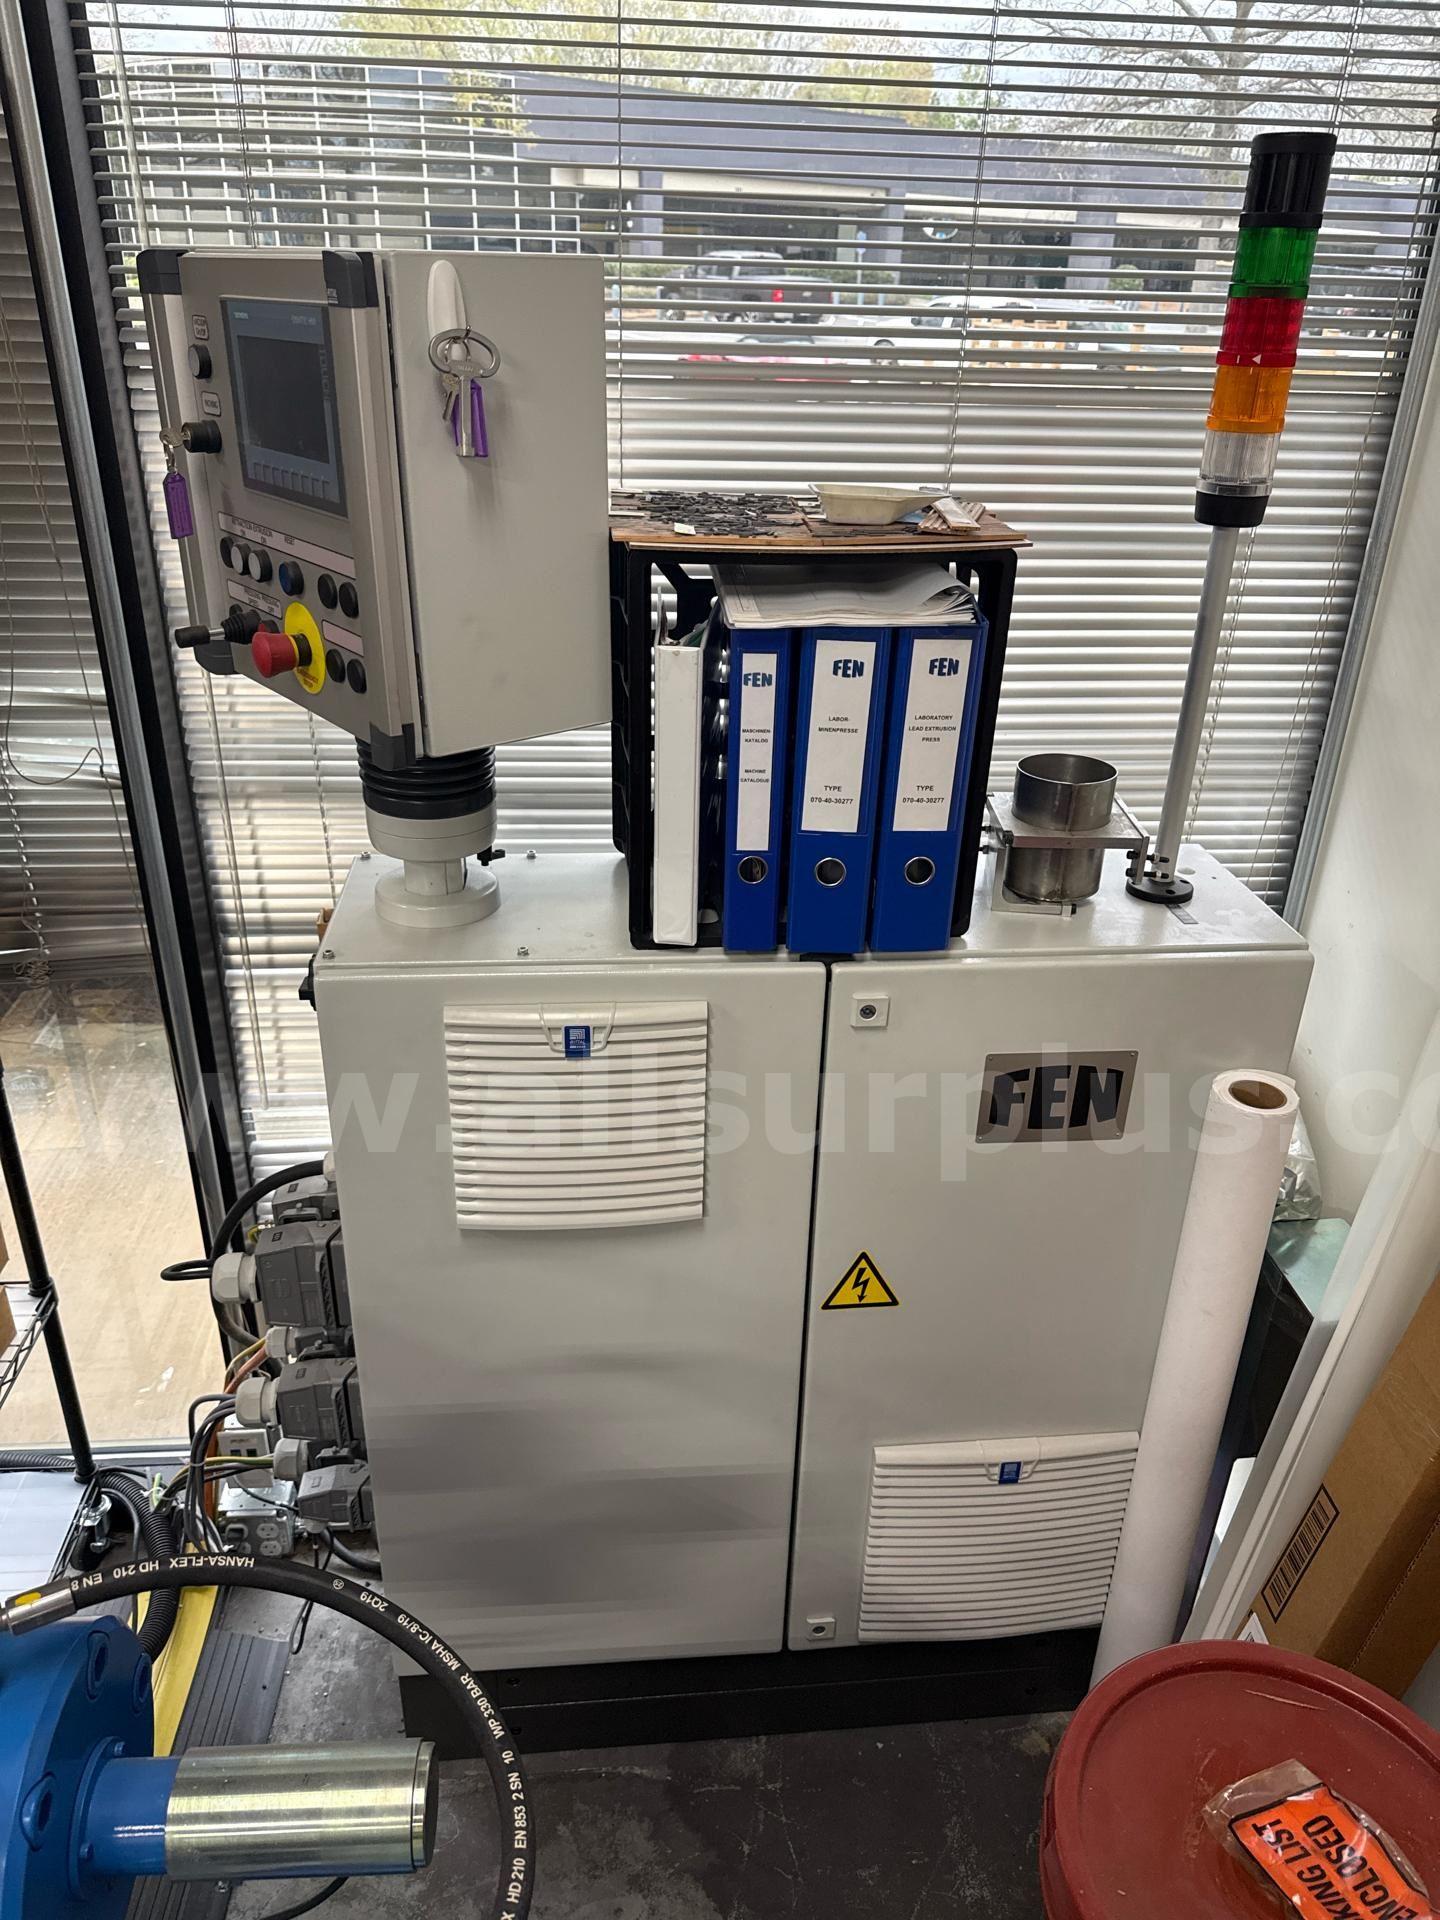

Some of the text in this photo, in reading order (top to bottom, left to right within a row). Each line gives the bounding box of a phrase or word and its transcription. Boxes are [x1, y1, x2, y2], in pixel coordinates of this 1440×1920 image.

[832, 659, 865, 678] FEN
[928, 657, 960, 677] FEN
[743, 672, 773, 688] FEN
[810, 797, 854, 805] 070-40-30277
[989, 1065, 1124, 1129] FEN
[113, 1564, 136, 1579] 210
[139, 1560, 159, 1574] HD
[169, 1555, 255, 1569] HANSA-FLEX
[82, 1572, 103, 1588] EN
[360, 1591, 389, 1612] 2Q19
[397, 1613, 434, 1645] IC-8/19
[430, 1639, 462, 1671] MSHA
[460, 1672, 483, 1698] BAR
[476, 1697, 495, 1717] 330
[488, 1717, 505, 1739] WP
[502, 1750, 516, 1764] 10
[508, 1772, 523, 1790] SN
[512, 1792, 524, 1800] 2
[514, 1805, 527, 1828] 853
[515, 1830, 527, 1849] EN
[511, 1857, 527, 1880] 210
[1252, 1818, 1362, 1920] KING LIST
[506, 1881, 522, 1904] HD
